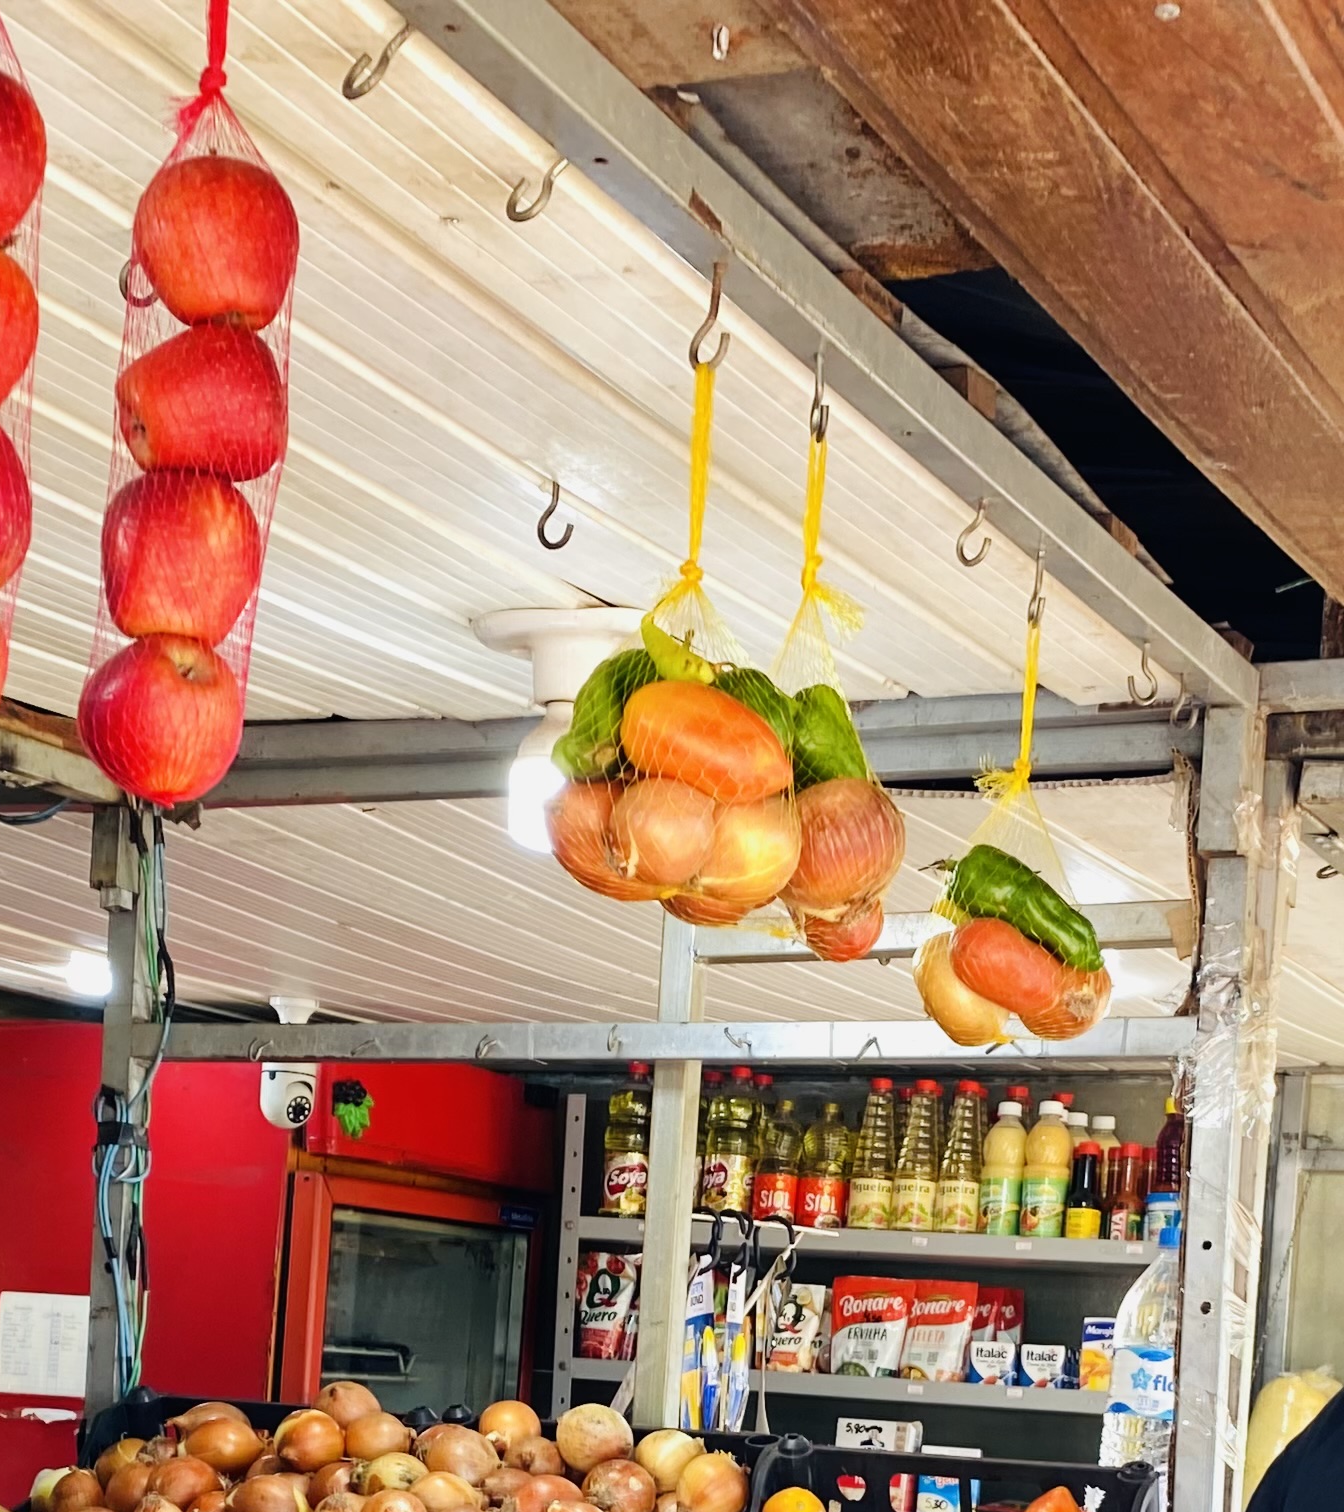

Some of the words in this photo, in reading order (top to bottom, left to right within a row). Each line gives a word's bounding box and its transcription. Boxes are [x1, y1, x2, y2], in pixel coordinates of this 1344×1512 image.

[609, 1170, 647, 1188] Soya
[839, 1294, 904, 1317] Bonare
[580, 1310, 618, 1325] Quero
[976, 1346, 1008, 1359] Italac
[1026, 1349, 1058, 1362] Italac
